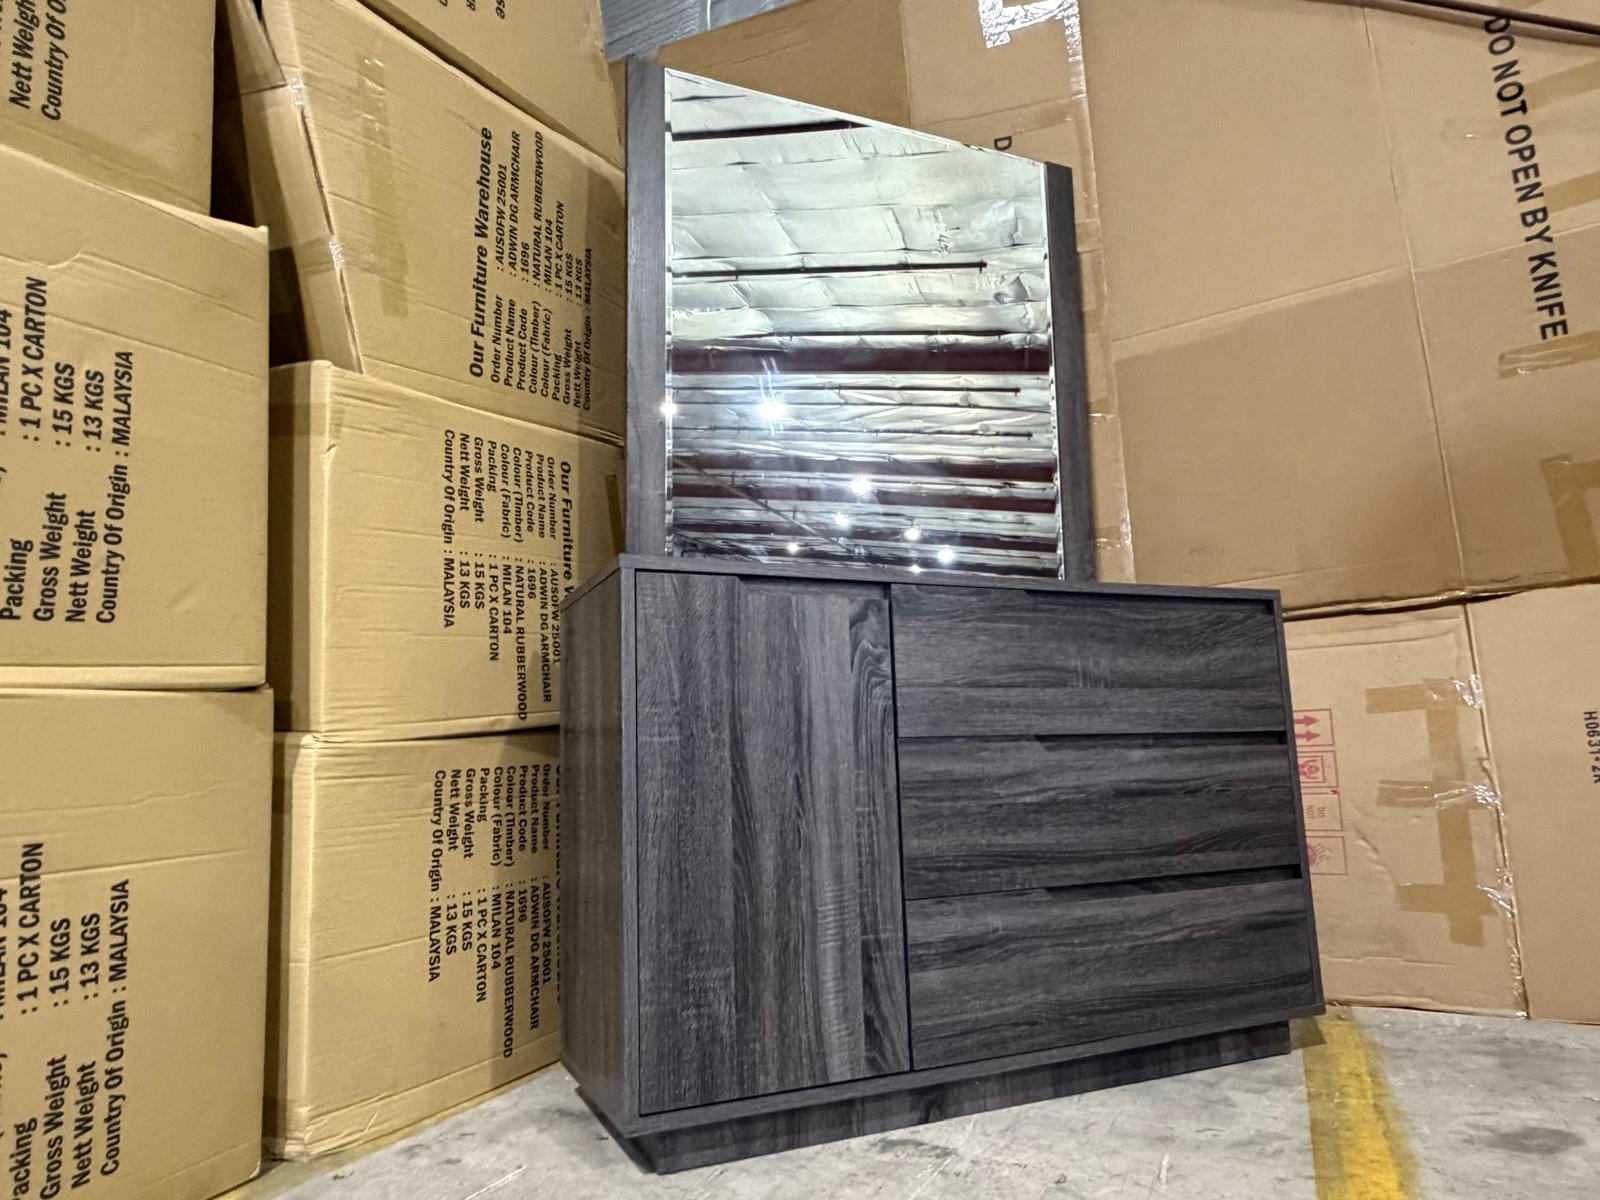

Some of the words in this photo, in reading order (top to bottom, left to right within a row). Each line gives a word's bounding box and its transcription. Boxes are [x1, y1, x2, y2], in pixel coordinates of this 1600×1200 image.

[46, 12, 65, 40] Of
[1484, 16, 1515, 56] DO
[9, 62, 32, 109] Nett
[41, 41, 68, 120] Country
[1493, 60, 1527, 116] NOT
[474, 128, 492, 238] Warehouse
[497, 164, 507, 206] 25001
[510, 131, 520, 203] ARMCHAIR
[534, 132, 543, 222] RUBBERWOOD
[1505, 125, 1544, 203] OPEN
[510, 204, 518, 224] DG
[556, 201, 564, 251] CARTON
[1520, 206, 1553, 242] BY
[496, 206, 505, 265] AUSOFW
[508, 225, 518, 268] ADWIN
[532, 226, 541, 280] NATURAL
[521, 242, 529, 274] 1696
[544, 246, 552, 285] MILAN
[555, 252, 563, 262] X
[555, 263, 562, 280] PC
[471, 246, 487, 338] Furniture
[565, 280, 572, 295] 15
[1528, 252, 1568, 340] KNIFE
[22, 277, 46, 360] CARTON
[492, 295, 502, 345] Number
[506, 299, 515, 336] Name
[518, 308, 527, 340] Code
[530, 301, 541, 352] (Timber)
[542, 308, 552, 356] (Fabric)
[470, 341, 484, 377] Our
[491, 347, 500, 383] Order
[504, 338, 514, 386] Product
[517, 342, 526, 390] Product
[564, 329, 572, 368] Weight
[22, 364, 43, 380] X
[54, 362, 74, 404] KGS
[84, 370, 104, 410] KGS
[529, 354, 538, 394] Colour
[541, 358, 549, 397] Colour
[552, 353, 562, 401] Packing
[20, 382, 42, 411] PC
[112, 352, 133, 446] MALAYSIA
[20, 418, 40, 428] 1
[52, 409, 73, 434] 15
[83, 416, 102, 440] 13
[442, 430, 455, 483] Country
[460, 433, 470, 462] Nett
[474, 437, 483, 473] Gross
[487, 440, 498, 492] Packing
[501, 444, 510, 486] Colour
[513, 448, 522, 488] Colour
[106, 465, 130, 520] Origin
[444, 486, 455, 502] Of
[458, 465, 470, 510] Weight
[525, 450, 534, 498] Product
[536, 454, 545, 501] Product
[561, 462, 571, 494] Our
[473, 478, 484, 522] Weight
[500, 488, 511, 538] (Fabric)
[513, 491, 523, 542] (Timber)
[527, 502, 535, 532] Code
[538, 504, 546, 538] Name
[39, 492, 68, 560] Weight
[70, 510, 98, 576] Weight
[104, 524, 122, 545] Of
[442, 504, 455, 544] Origin
[562, 498, 573, 580] Furniture
[0, 538, 34, 620] Packing
[96, 550, 125, 623] Country
[460, 560, 470, 577] 13
[475, 562, 484, 578] 15
[489, 575, 498, 592] PC
[503, 564, 512, 606] MILAN
[528, 568, 536, 599] 1696
[540, 568, 548, 609] ADWIN
[33, 567, 59, 621] Gross
[65, 582, 88, 622] Nett
[444, 558, 454, 628] MALAYSIA
[460, 581, 470, 608] KGS
[475, 582, 485, 609] KGS
[489, 595, 498, 603] X
[516, 566, 524, 623] NATURAL
[489, 607, 499, 660] CARTON
[503, 610, 512, 634] 104
[540, 613, 548, 630] DG
[516, 627, 528, 720] RUBBERWOOD
[540, 633, 551, 702] ARMCHAIR
[430, 770, 446, 825] Country
[450, 770, 461, 799] Nett
[464, 768, 476, 808] Gross
[477, 768, 490, 822] Packing
[493, 766, 503, 810] Colour
[506, 766, 516, 808] Colour
[519, 765, 528, 816] Product
[530, 764, 540, 814] Product
[432, 829, 443, 844] Of
[446, 802, 460, 851] Weight
[462, 810, 474, 859] Weight
[491, 814, 502, 866] (Fabric)
[504, 812, 515, 866] (Timber)
[519, 819, 527, 851] Code
[531, 817, 539, 853] Name
[19, 843, 43, 928] CARTON
[428, 848, 442, 892] Origin
[446, 904, 457, 921] 13
[462, 900, 472, 918] 15
[477, 909, 488, 928] PC
[478, 898, 487, 906] 1
[492, 894, 502, 938] MILAN
[505, 890, 514, 953] NATURAL
[518, 889, 527, 922] 1696
[531, 886, 539, 930] ADWIN
[18, 933, 39, 948] X
[50, 918, 70, 962] KGS
[81, 914, 100, 956] KGS
[109, 879, 128, 982] MALAYSIA
[429, 906, 441, 982] MALAYSIA
[446, 925, 457, 955] KGS
[462, 922, 472, 951] KGS
[477, 931, 487, 941] X
[18, 952, 39, 982] PC
[80, 962, 99, 987] 13
[477, 944, 487, 1002] CARTON
[492, 942, 501, 969] 104
[16, 987, 38, 1001] 1
[49, 967, 69, 994] 15
[530, 956, 540, 1030] ARMCHAIR
[504, 956, 514, 1058] RUBBERWOOD
[106, 1000, 129, 1062] Origin
[43, 1055, 70, 1135] Weight
[104, 1067, 123, 1090] Of
[74, 1061, 99, 1139] Weight
[100, 1094, 126, 1176] Country
[9, 1117, 38, 1200] acking
[40, 1136, 63, 1200] Gross
[71, 1138, 92, 1189] Nett
